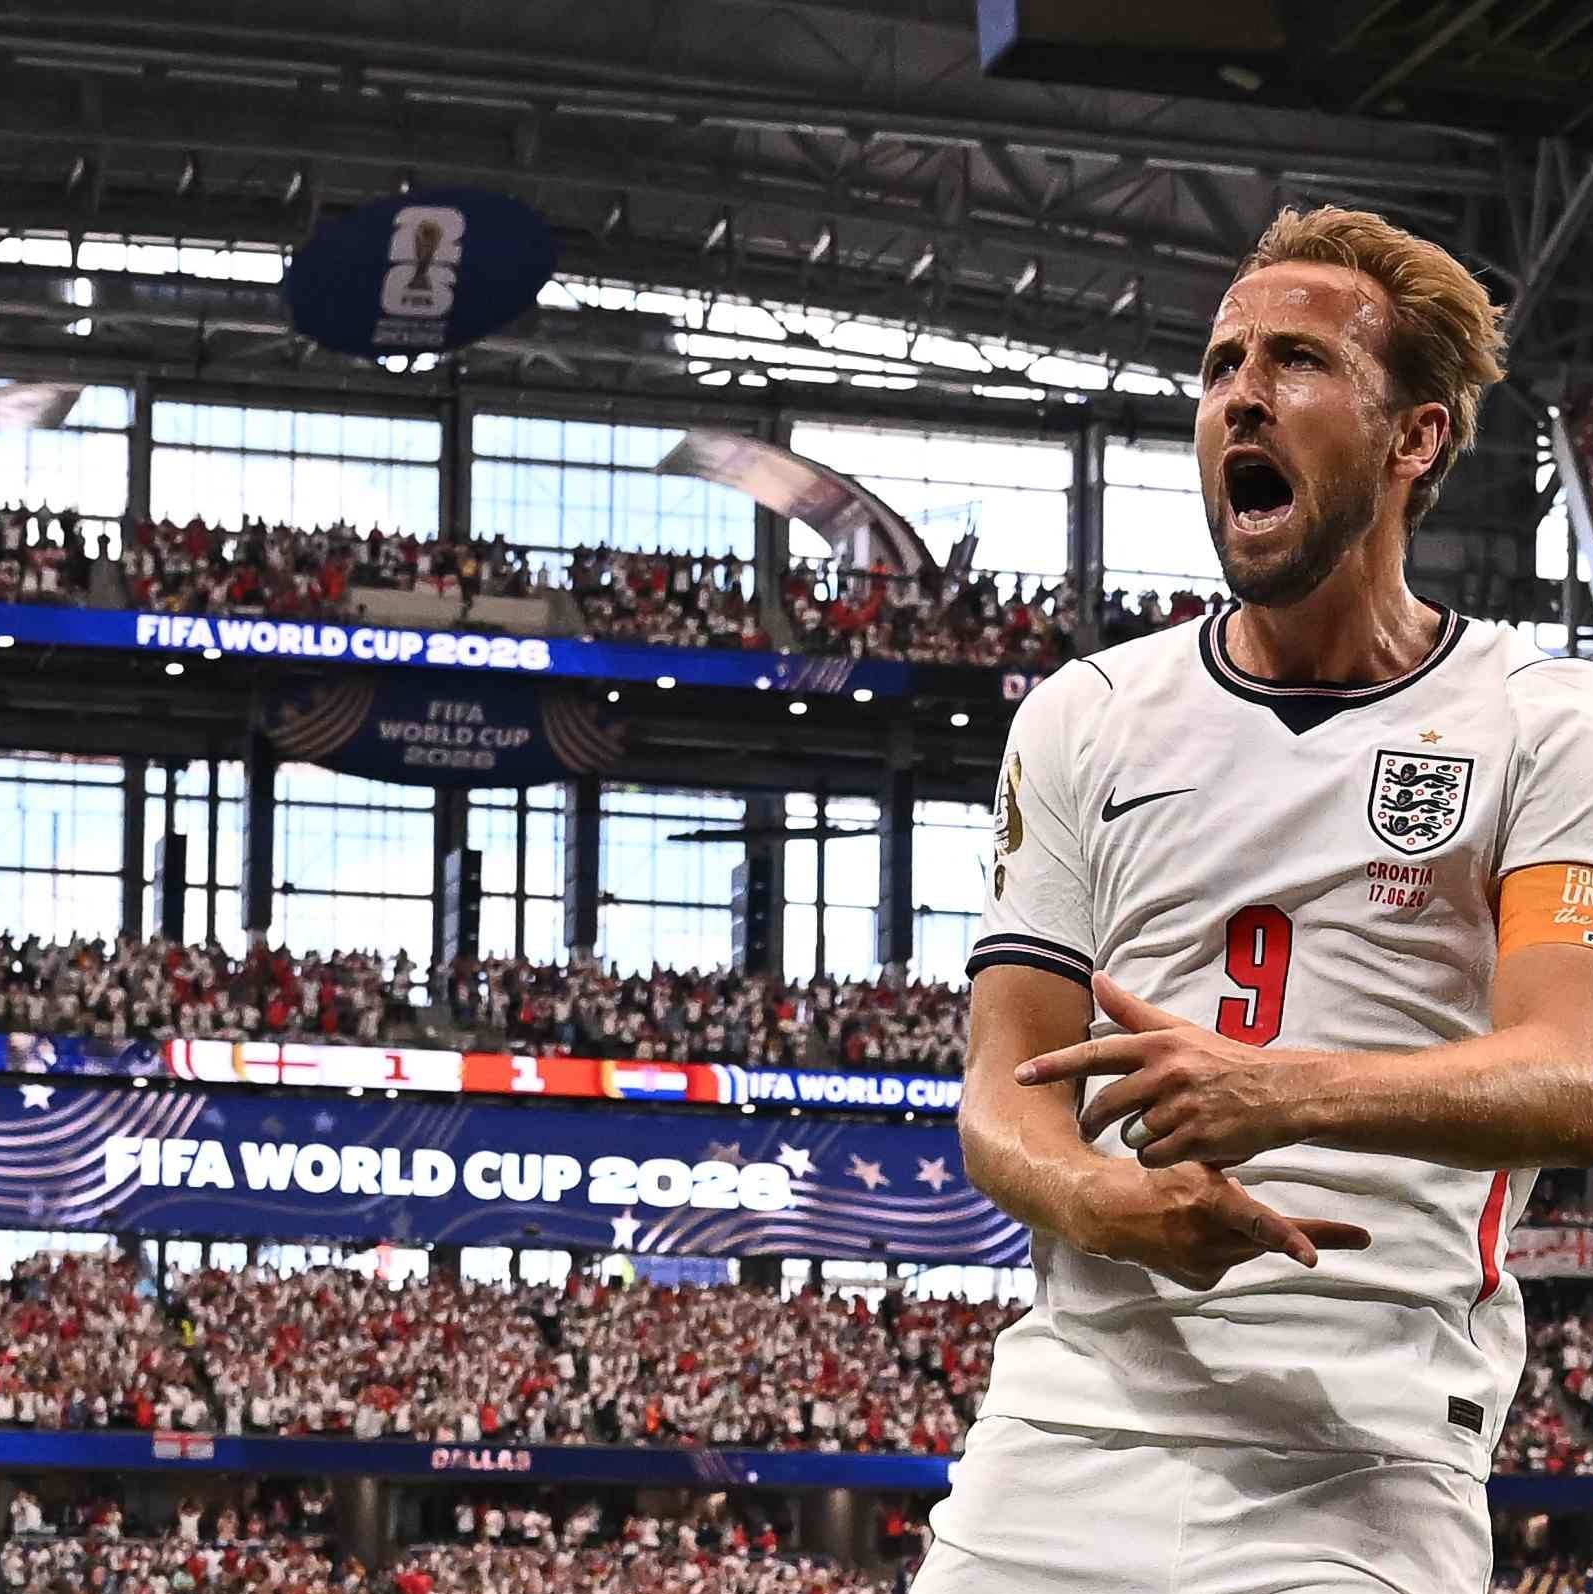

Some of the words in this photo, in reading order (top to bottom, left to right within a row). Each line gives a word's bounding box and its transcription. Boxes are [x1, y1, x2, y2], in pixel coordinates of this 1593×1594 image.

[136, 614, 214, 648] FIFA
[218, 619, 347, 657] WORLD
[351, 629, 423, 661] CUP
[425, 633, 551, 670] 2026
[428, 701, 485, 722] FIFA
[379, 721, 474, 746] WORLD
[479, 727, 530, 746] CUP
[1366, 861, 1433, 886] CROATIA
[1368, 884, 1426, 908] 17.06.26
[1554, 907, 1593, 926] the
[1214, 903, 1293, 1047] 9
[385, 1055, 410, 1081] 1
[511, 1056, 545, 1092] 1
[797, 1075, 904, 1105] WORLD
[103, 1136, 234, 1190] FIFA
[239, 1143, 456, 1198] WORLD
[461, 1151, 581, 1203] CUP
[588, 1156, 792, 1211] 2026
